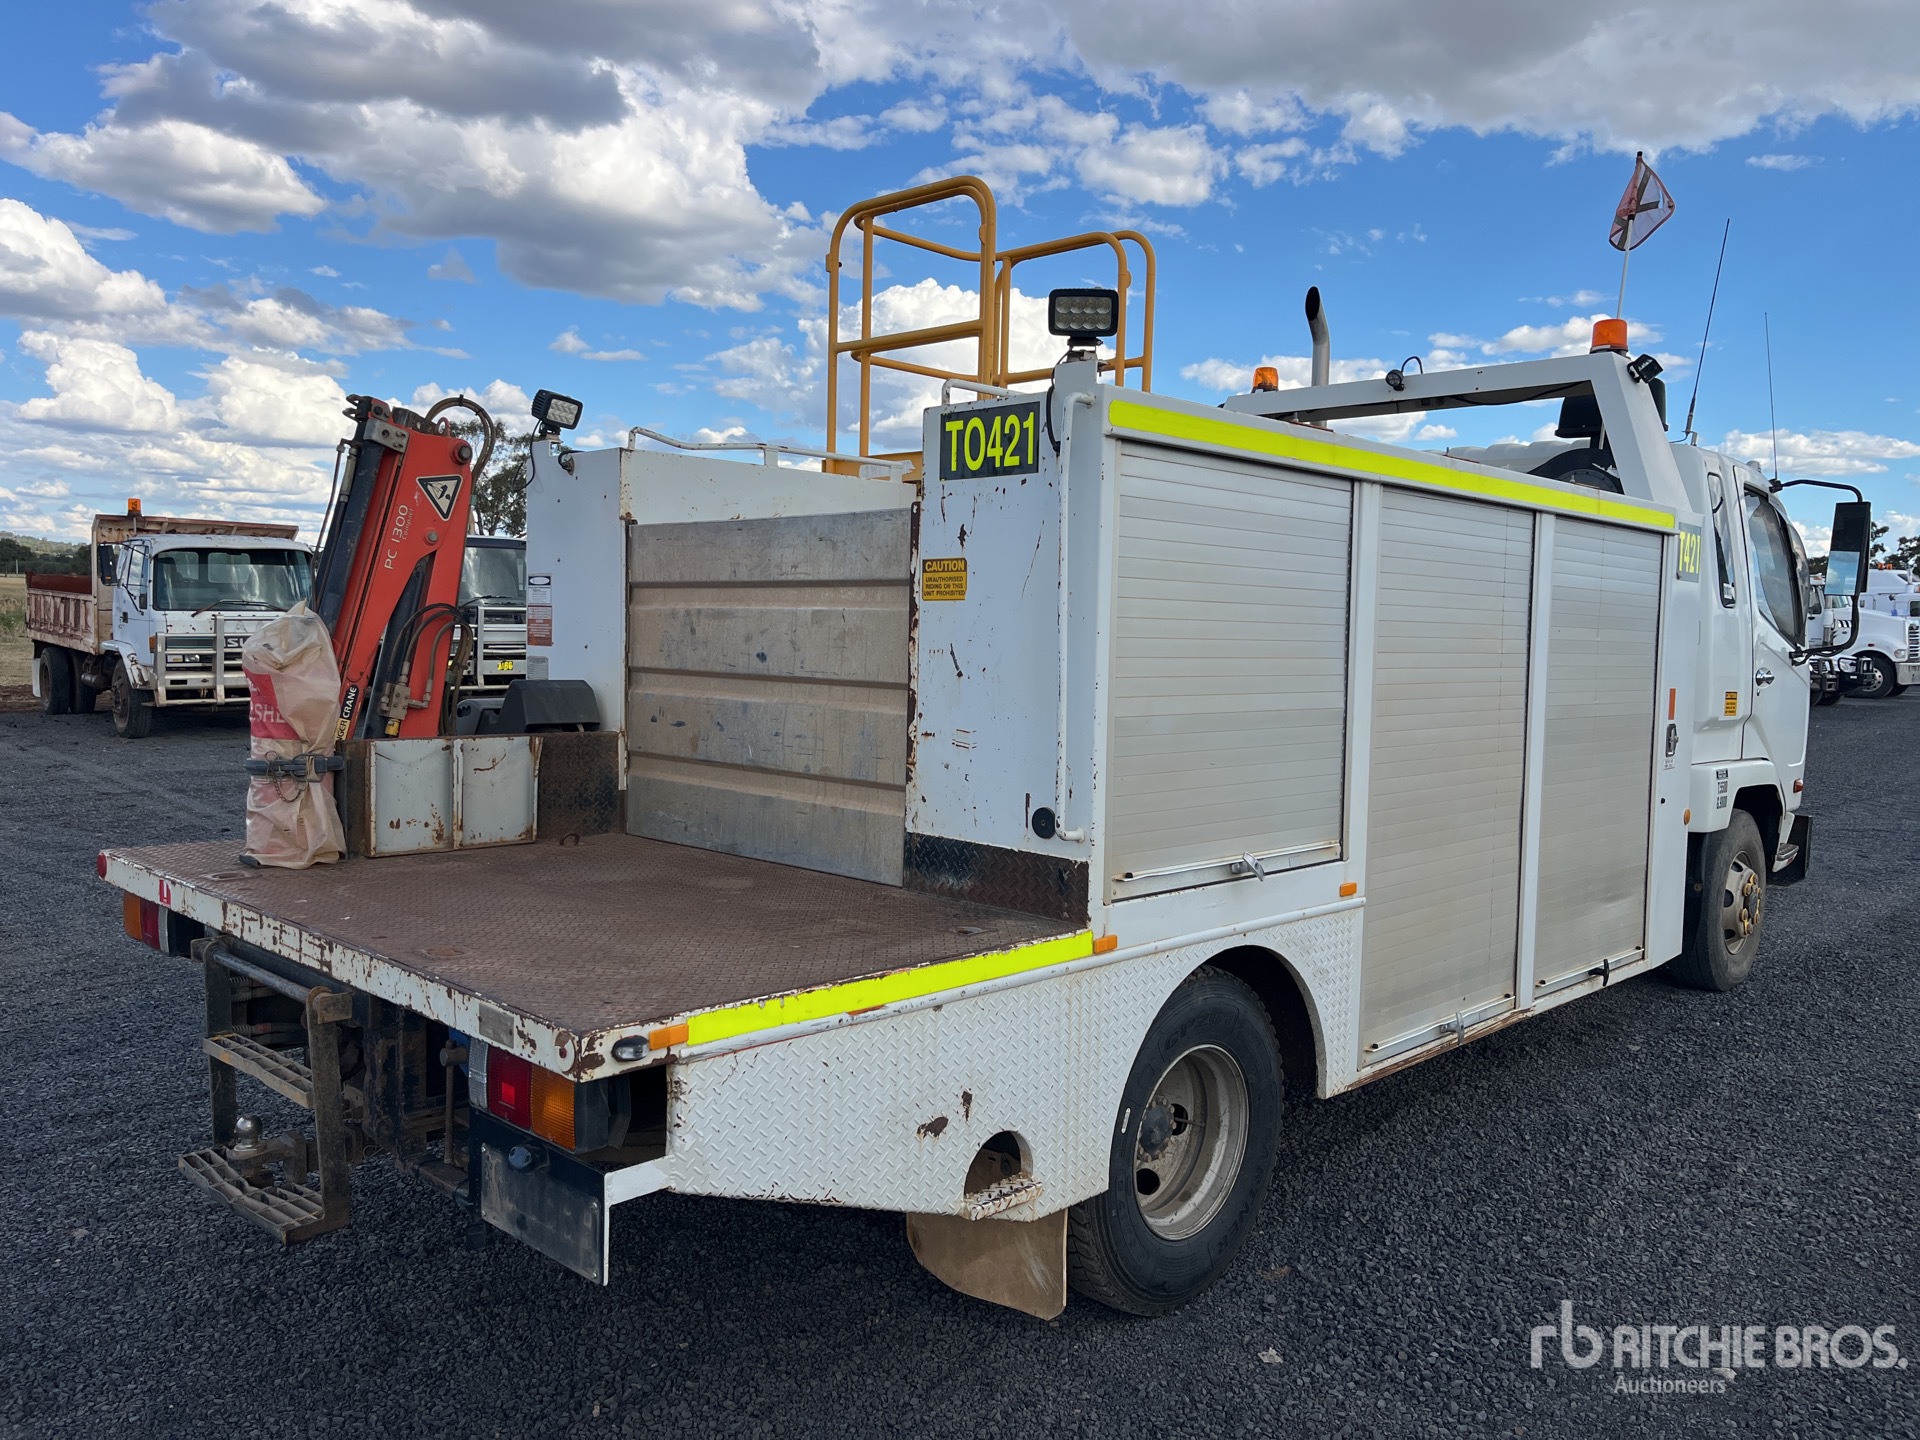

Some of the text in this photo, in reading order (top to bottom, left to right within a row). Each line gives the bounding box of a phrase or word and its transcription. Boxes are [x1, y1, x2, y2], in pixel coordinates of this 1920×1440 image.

[384, 504, 409, 570] PC 1300
[1679, 531, 1701, 574] T421
[925, 560, 966, 572] CAUTION
[342, 686, 357, 718] CRANE
